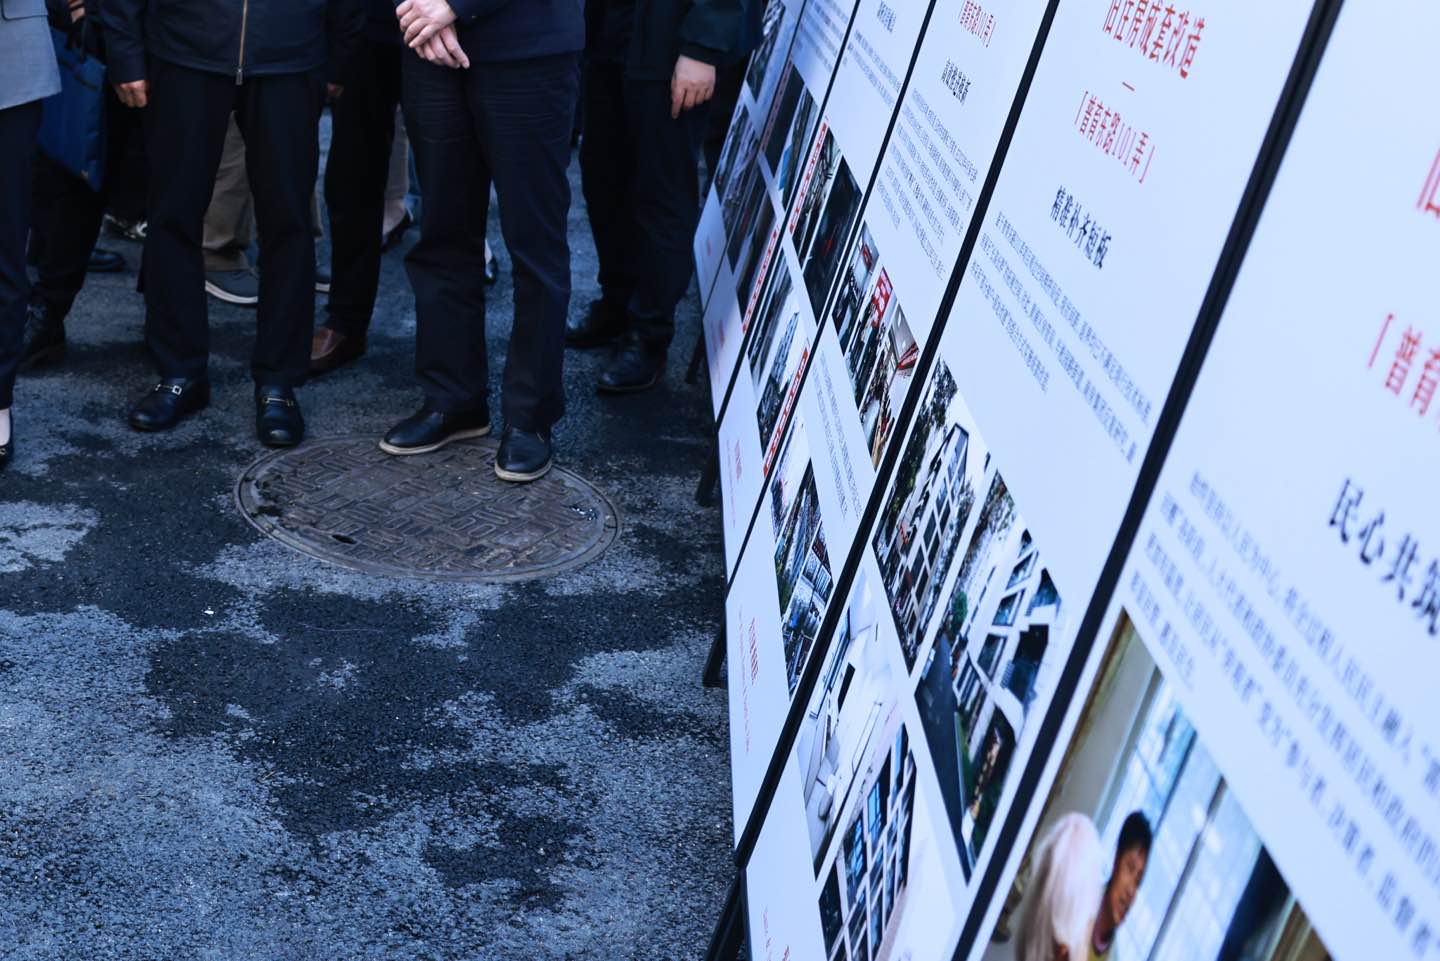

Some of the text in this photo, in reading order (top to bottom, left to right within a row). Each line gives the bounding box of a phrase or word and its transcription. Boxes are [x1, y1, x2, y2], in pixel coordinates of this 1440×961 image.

[1074, 89, 1156, 184] 「普育东路101弄」
[1050, 184, 1113, 270] 精准补齐短板
[1366, 311, 1440, 430] 「普育
